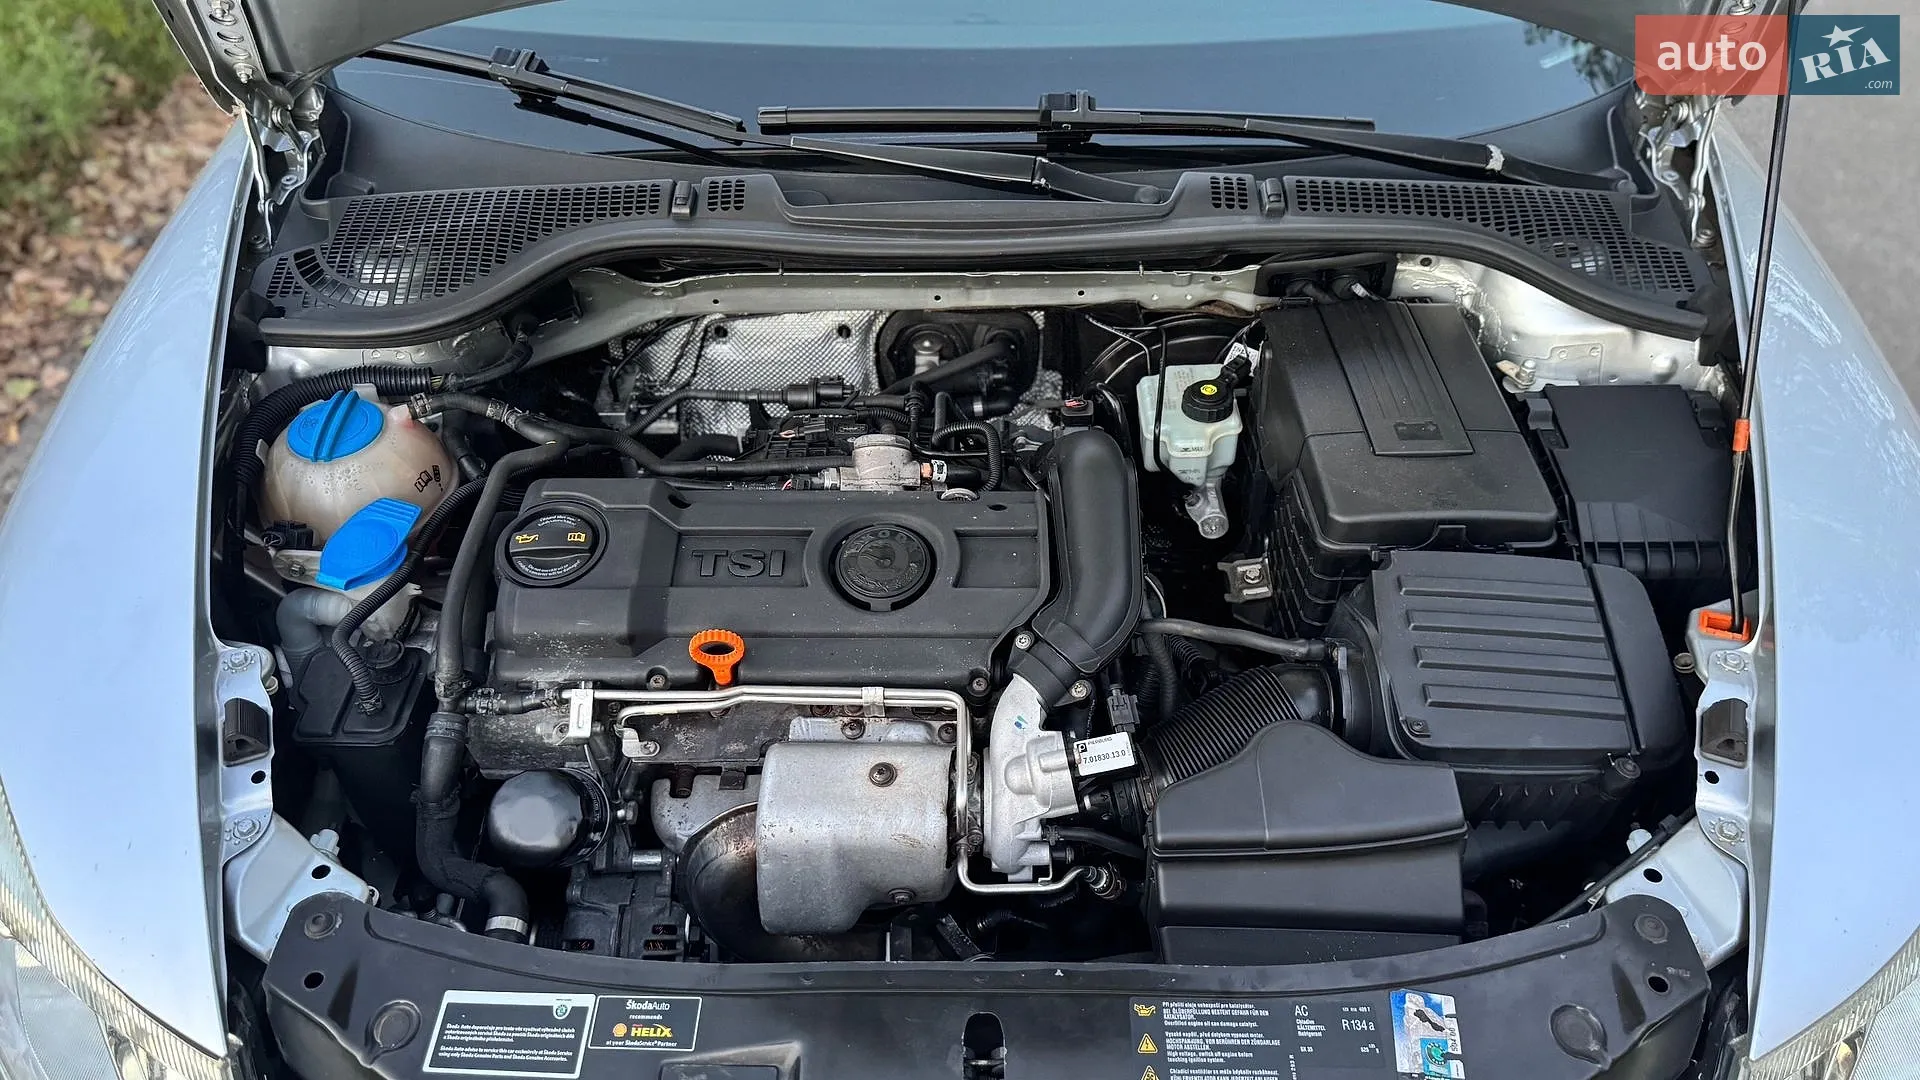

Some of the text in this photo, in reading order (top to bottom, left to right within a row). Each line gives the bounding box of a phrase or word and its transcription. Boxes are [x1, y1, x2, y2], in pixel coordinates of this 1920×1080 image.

[692, 549, 786, 577] TSI
[1295, 1005, 1308, 1017] AC
[1342, 1018, 1375, 1031] R 134 a
[631, 1027, 672, 1038] HELIX
